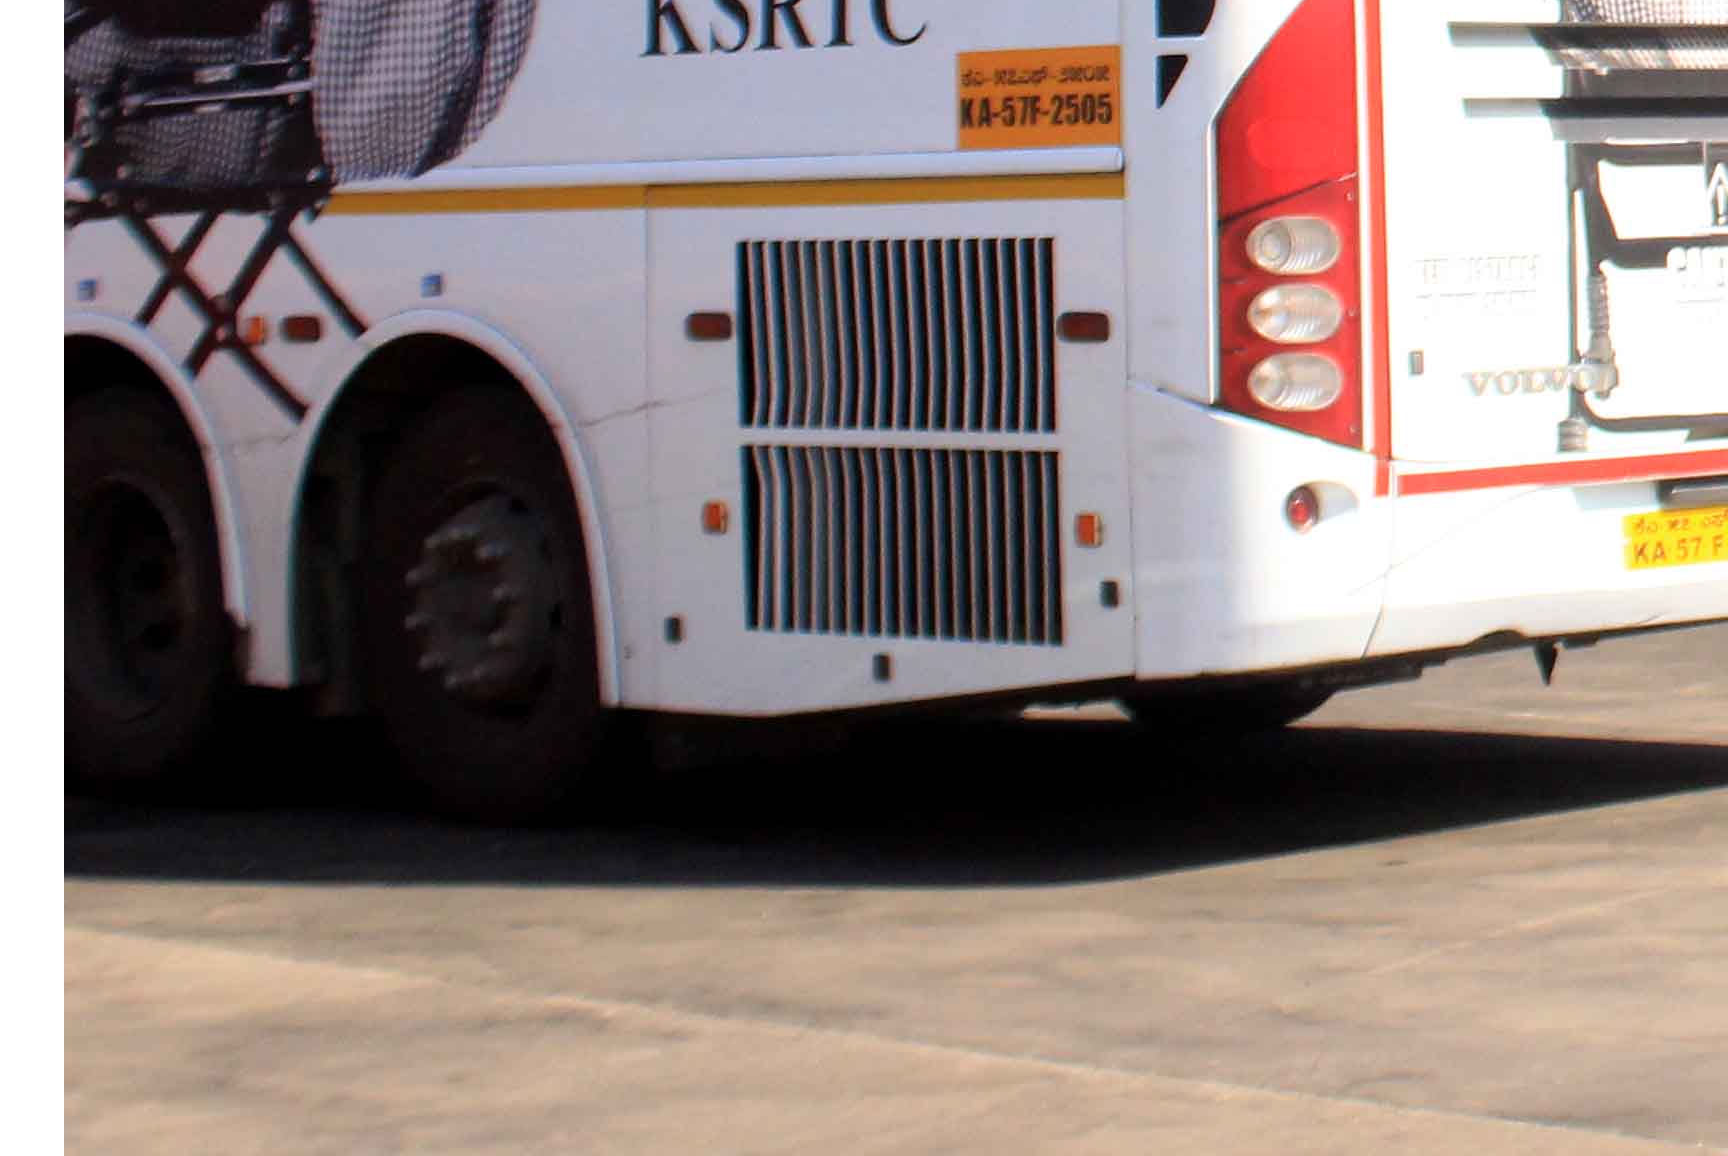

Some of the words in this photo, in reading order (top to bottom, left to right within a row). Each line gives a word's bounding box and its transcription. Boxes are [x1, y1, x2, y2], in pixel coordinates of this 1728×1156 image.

[960, 93, 1113, 130] KA-57F-2505
[1460, 363, 1600, 397] VOLVO
[1633, 540, 1667, 564] KA
[1676, 536, 1703, 560] 57
